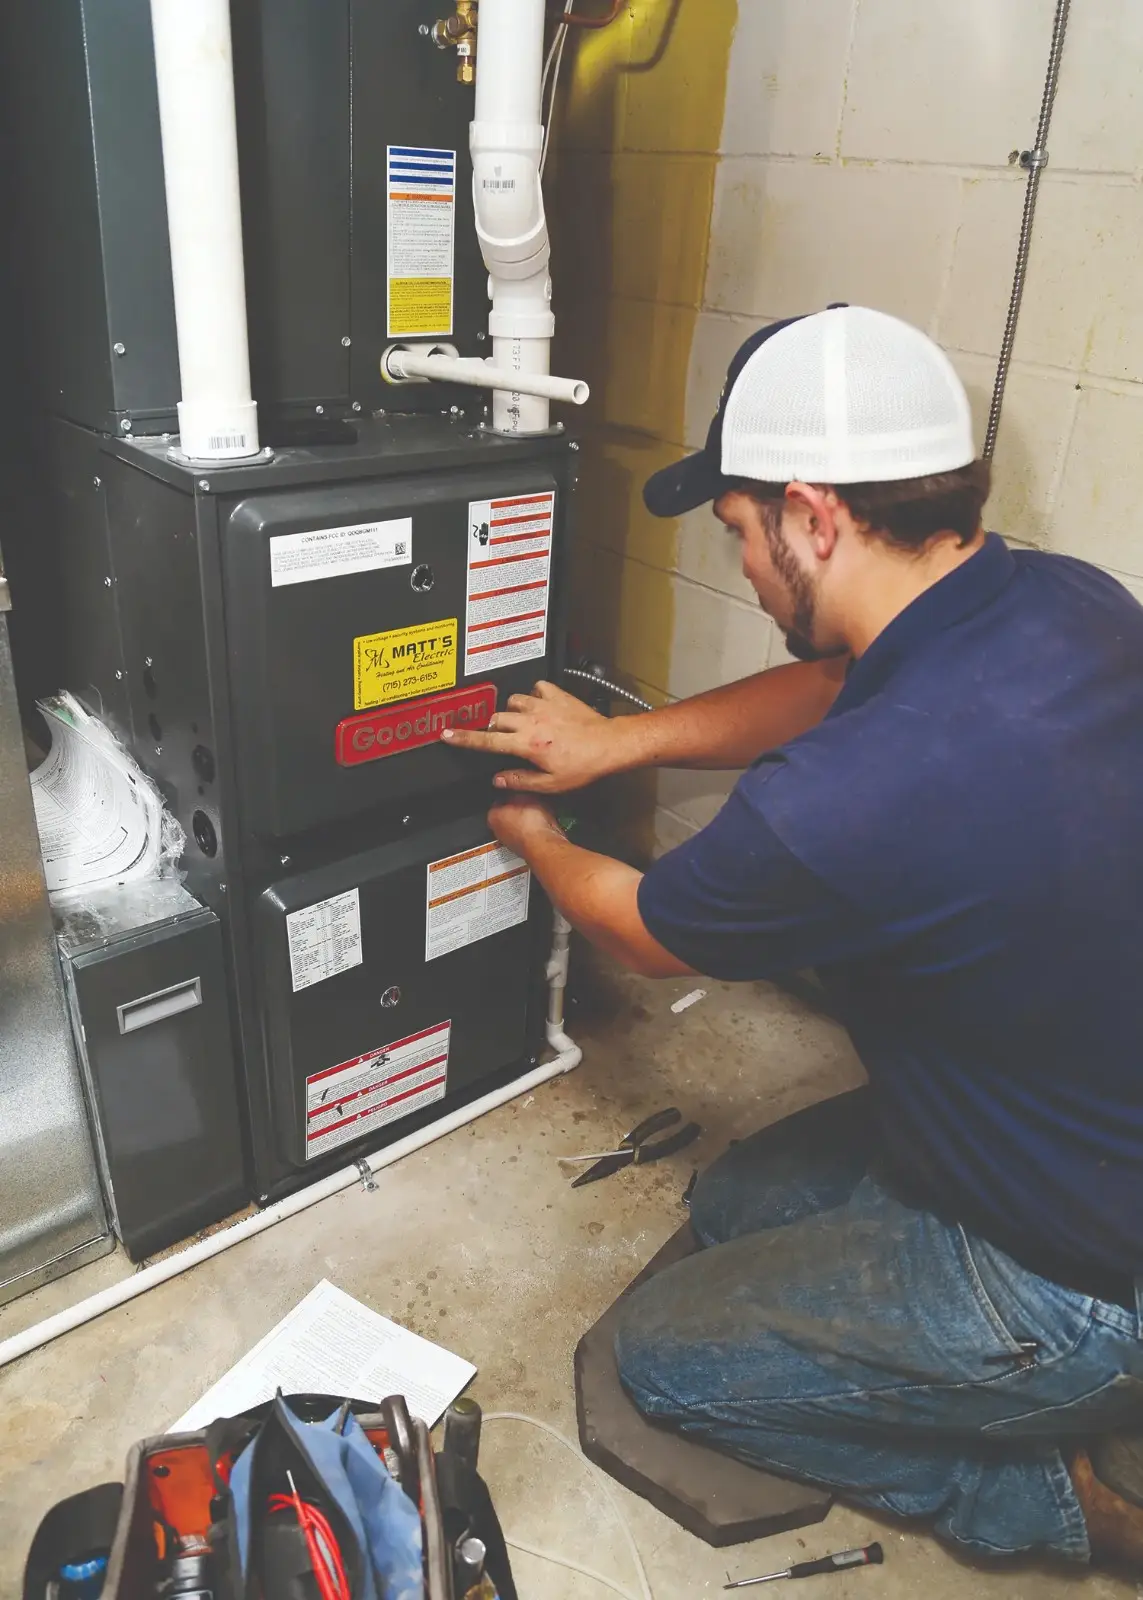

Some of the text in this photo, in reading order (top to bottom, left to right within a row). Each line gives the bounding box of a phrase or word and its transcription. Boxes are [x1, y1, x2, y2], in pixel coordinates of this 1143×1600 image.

[301, 533, 328, 543] CONTAINS
[392, 635, 452, 659] MATT'S
[413, 648, 454, 663] Electric
[376, 670, 395, 678] Heating
[416, 659, 444, 670] Conditioning
[382, 672, 438, 692] (715) 273-6153
[352, 699, 487, 751] Goodman
[370, 1047, 390, 1058] DANGER
[368, 1080, 388, 1092] DANGER
[368, 1102, 388, 1114] PELIGRO
